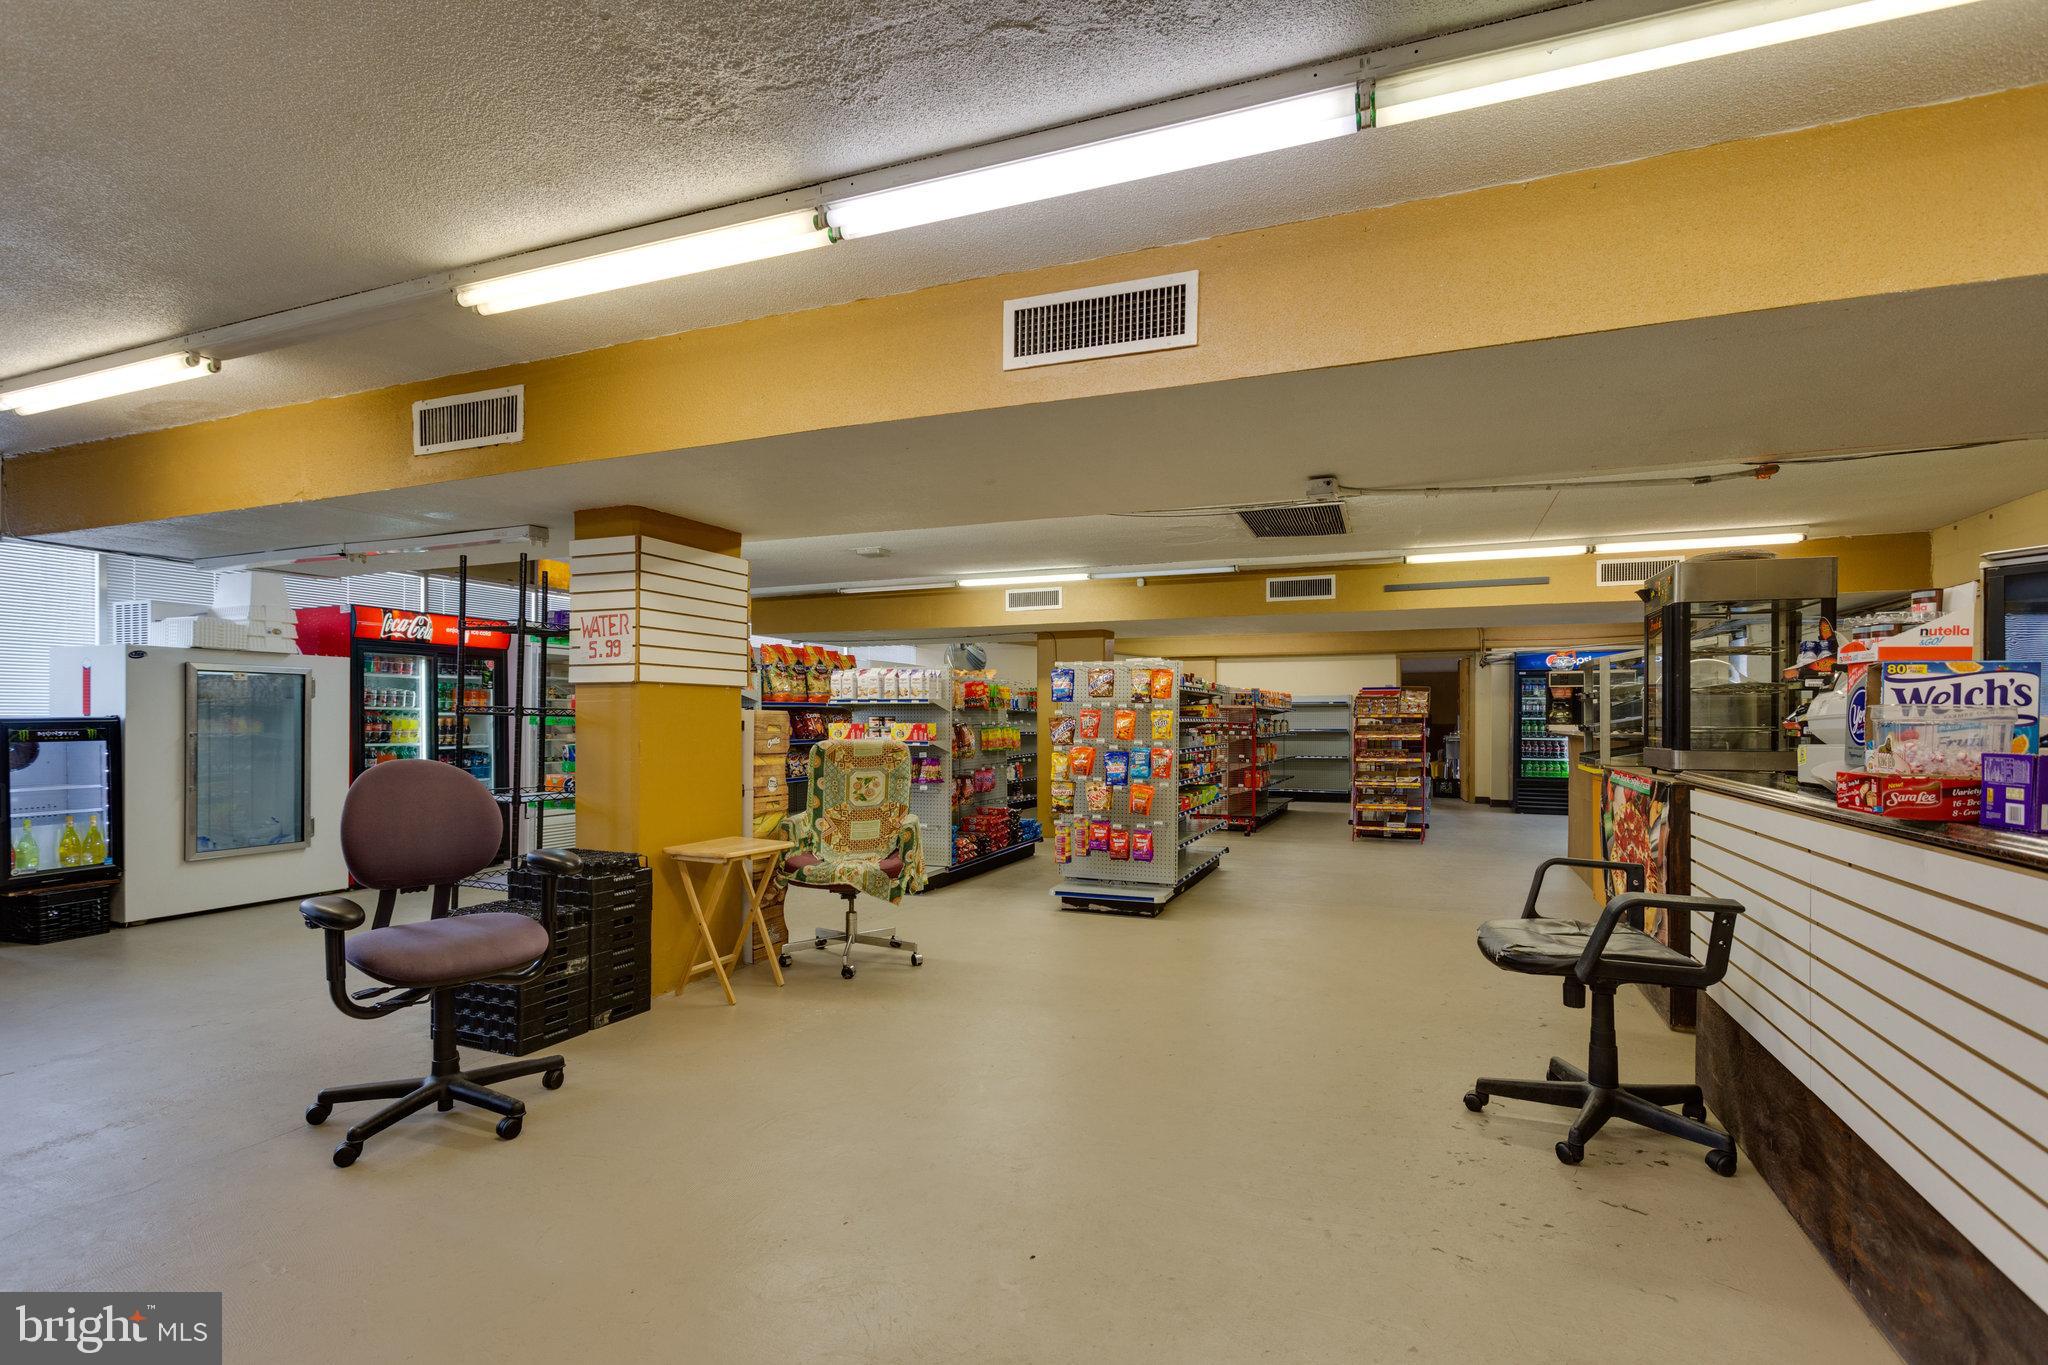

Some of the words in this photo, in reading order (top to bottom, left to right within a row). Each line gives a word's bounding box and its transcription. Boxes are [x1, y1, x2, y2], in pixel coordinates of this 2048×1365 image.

[380, 612, 433, 639] Coca-Cola
[581, 613, 629, 639] WATER
[1920, 624, 1970, 636] nutella
[589, 639, 621, 659] 5.99
[1887, 663, 1907, 675] 80
[1890, 678, 2033, 716] Welch's
[1952, 787, 1982, 797] Variety
